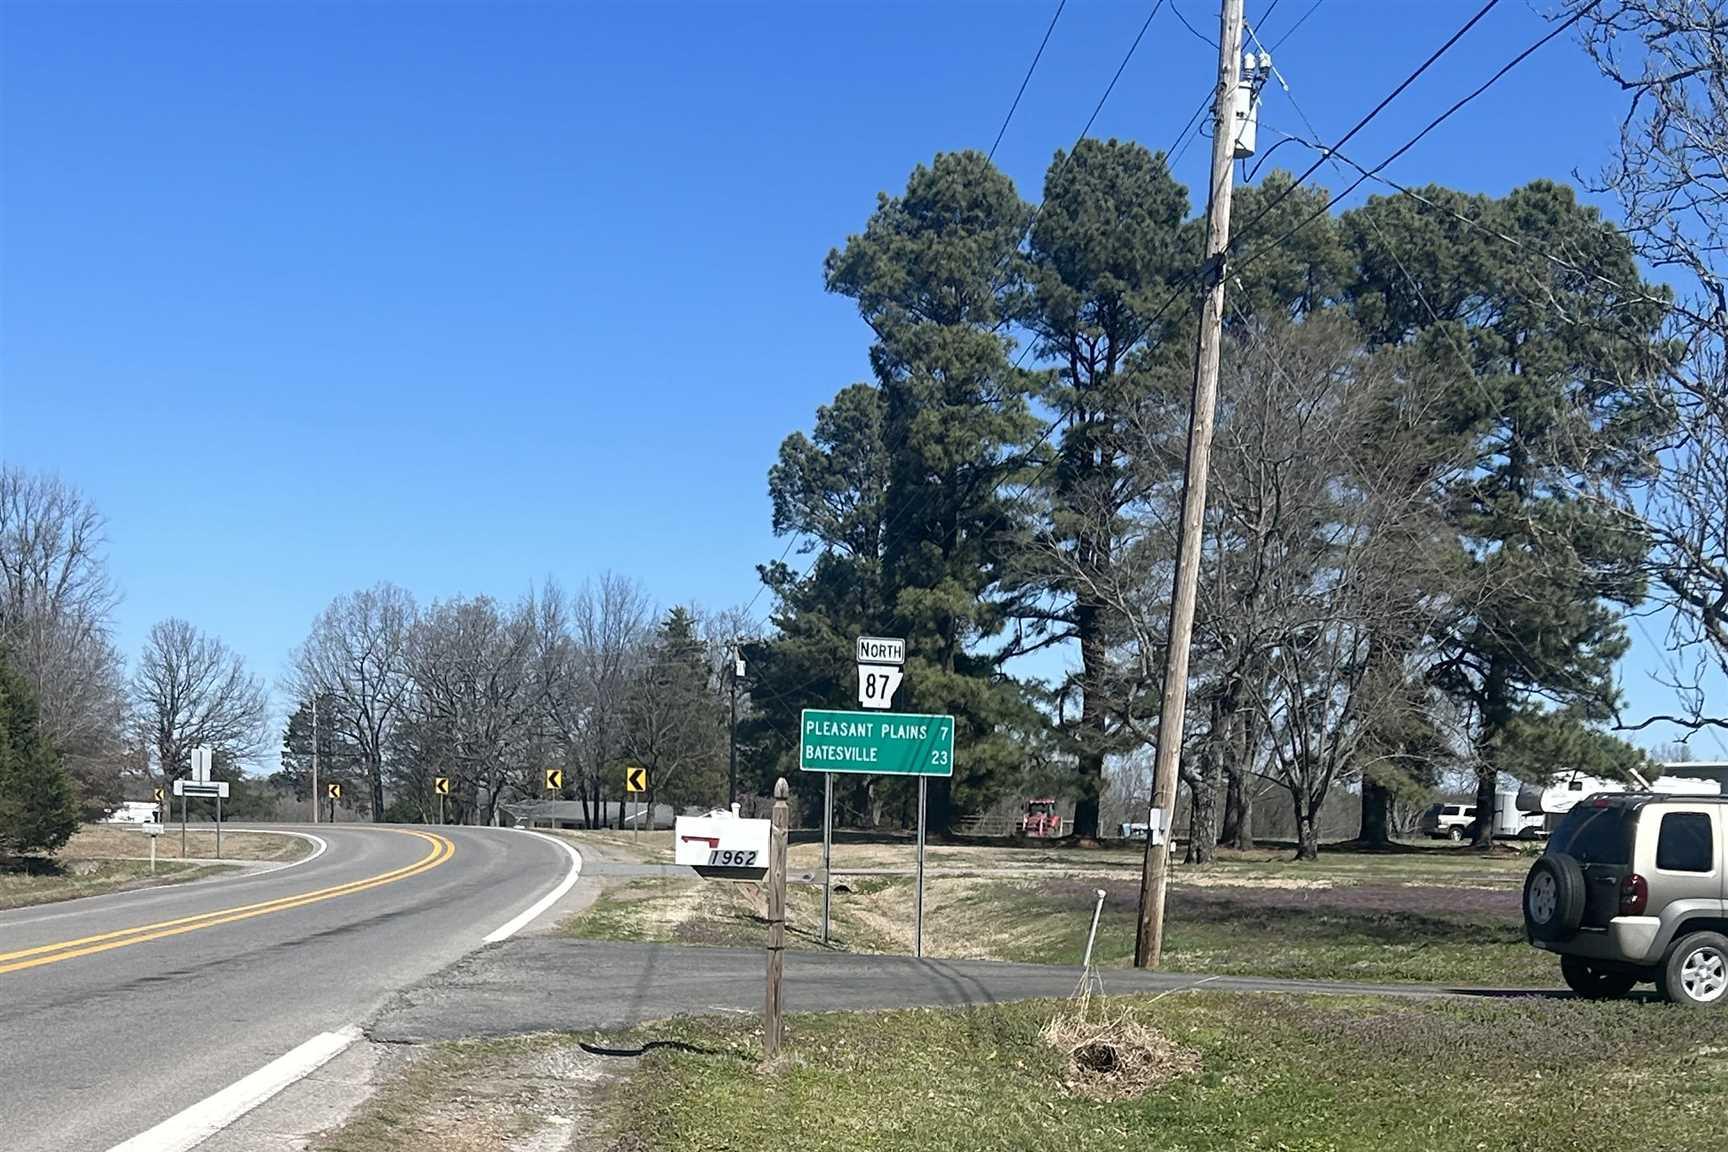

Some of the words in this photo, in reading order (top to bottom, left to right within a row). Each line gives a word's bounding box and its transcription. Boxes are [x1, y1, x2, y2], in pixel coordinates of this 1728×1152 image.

[860, 642, 902, 658] NORTH
[865, 673, 890, 699] 87
[806, 720, 873, 738] PLEASANT
[881, 724, 928, 740] PLAINS
[940, 727, 949, 741] 7
[805, 745, 878, 762] BATESVILLE
[931, 751, 948, 766] 23
[711, 850, 756, 866] 1962
